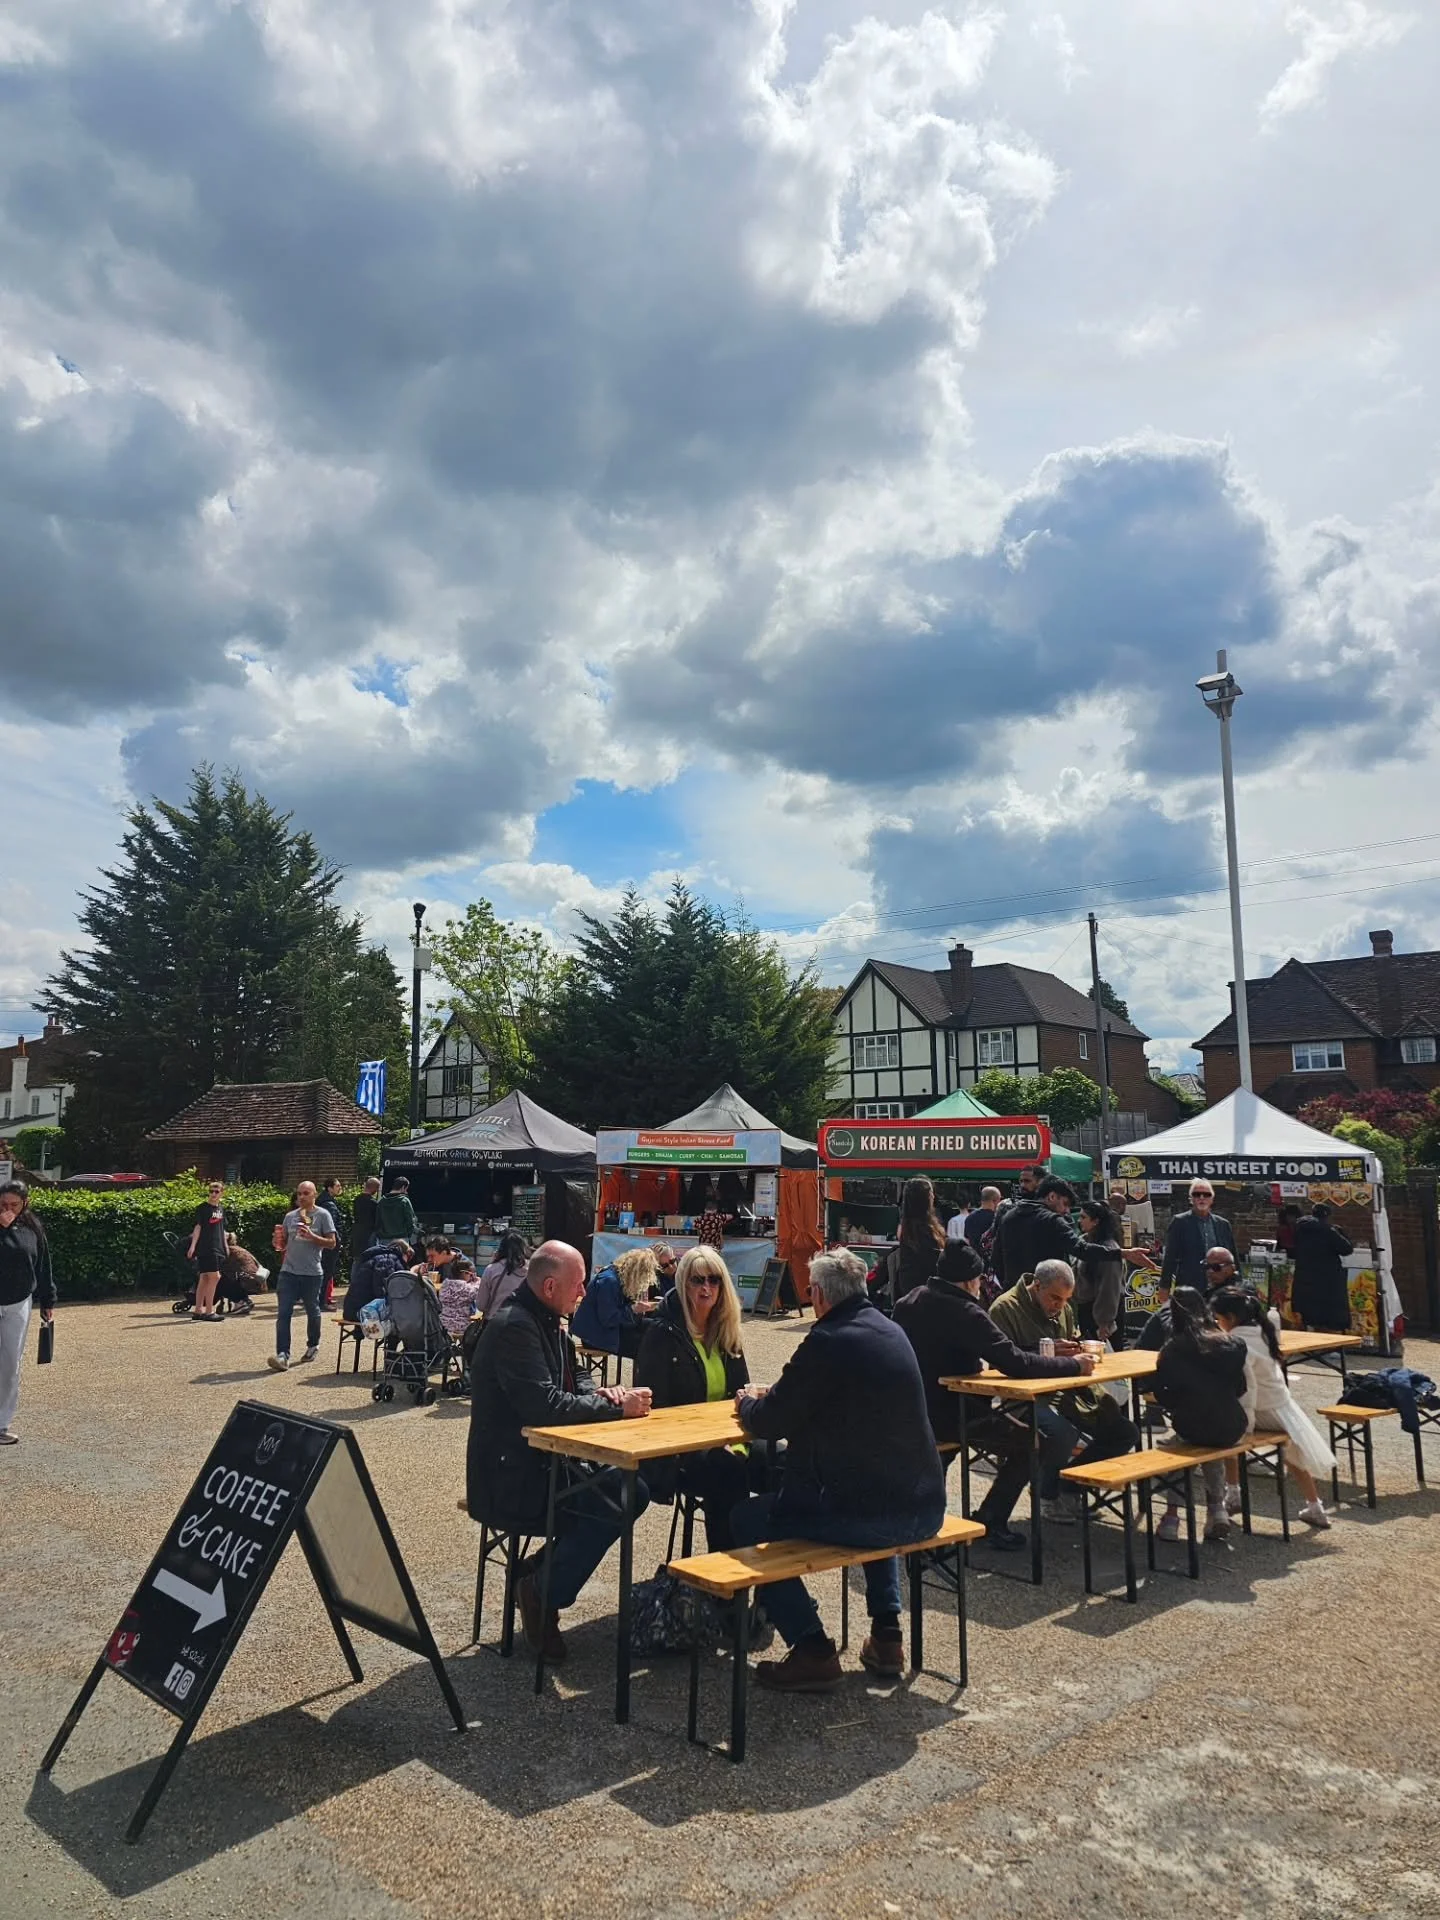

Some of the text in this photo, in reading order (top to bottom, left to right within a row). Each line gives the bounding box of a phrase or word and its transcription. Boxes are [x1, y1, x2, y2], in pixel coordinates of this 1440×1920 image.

[860, 1135, 916, 1151] KOREAN
[921, 1135, 964, 1151] FRIED
[970, 1134, 1037, 1150] CHICKEN
[1159, 1161, 1199, 1174] THAI
[1203, 1161, 1270, 1175] STREET
[1275, 1161, 1328, 1176] FOOD
[1128, 1298, 1151, 1308] FOOD
[203, 1465, 290, 1527] COFFEE
[178, 1507, 262, 1579] & CAKE
